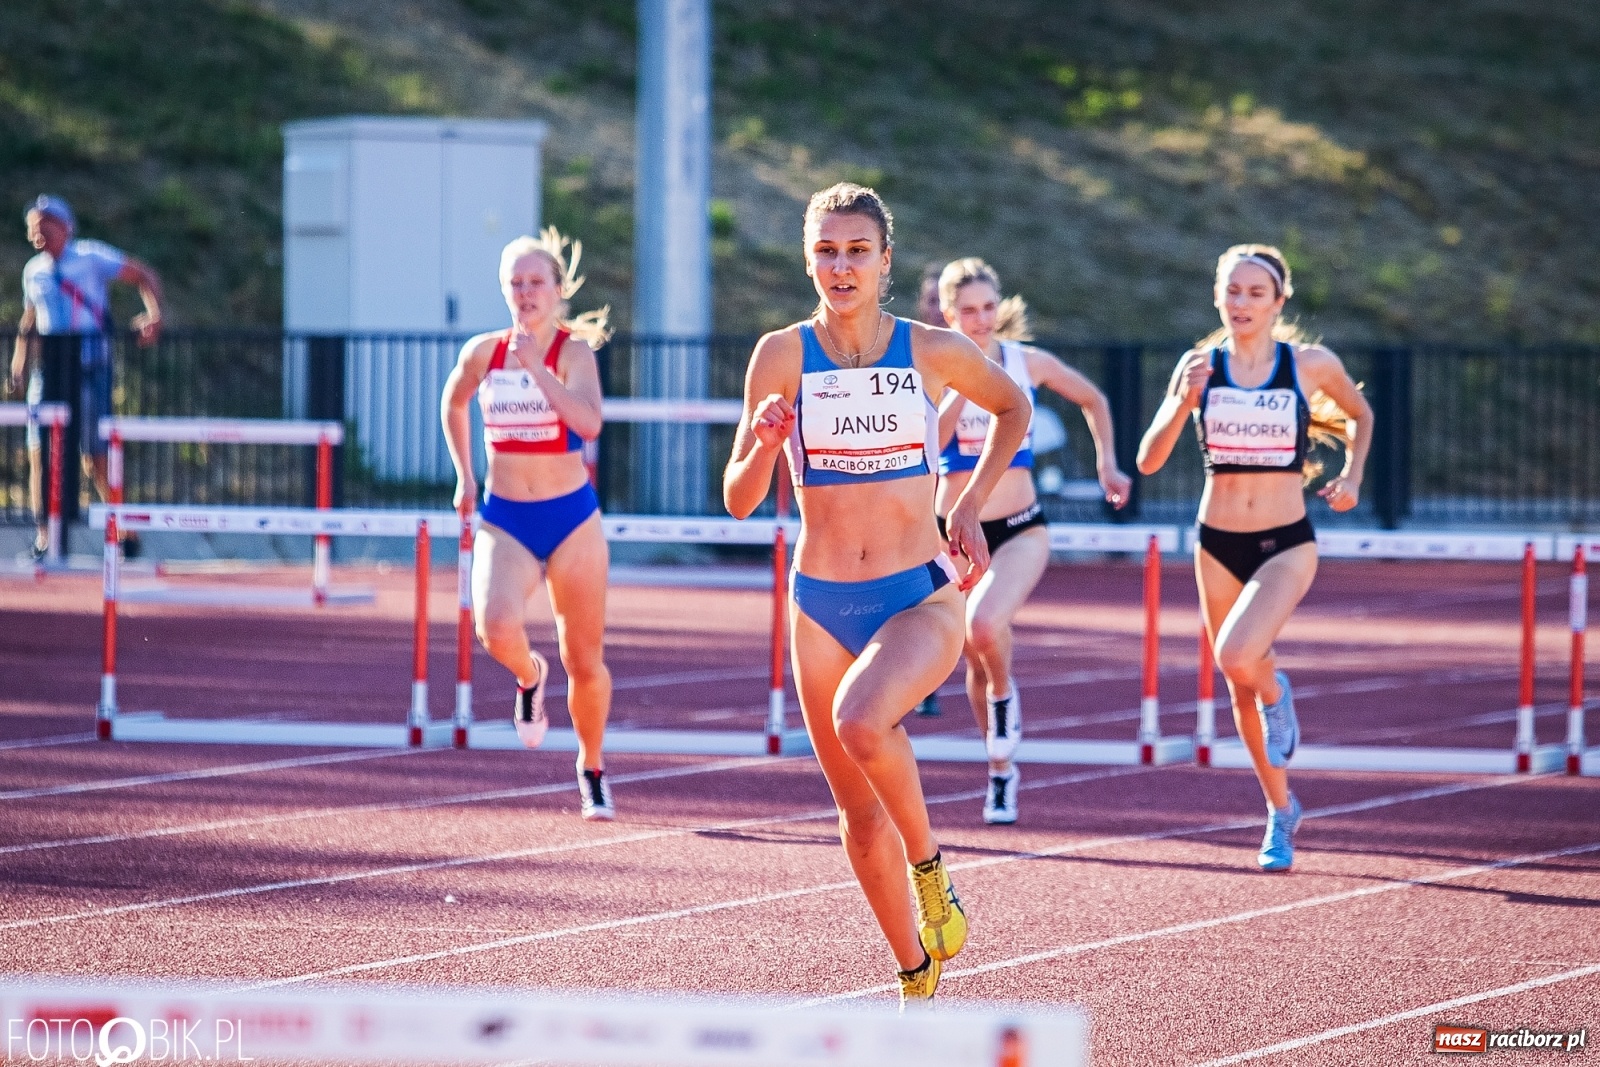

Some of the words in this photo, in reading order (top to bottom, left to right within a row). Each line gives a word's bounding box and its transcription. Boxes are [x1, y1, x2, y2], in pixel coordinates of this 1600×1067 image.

[869, 372, 917, 396] 194
[1254, 394, 1291, 411] 467
[831, 414, 898, 435] JANUS
[1211, 421, 1290, 438] JACHOREK
[822, 458, 881, 471] RACIBÓRZ
[885, 455, 908, 468] 2019
